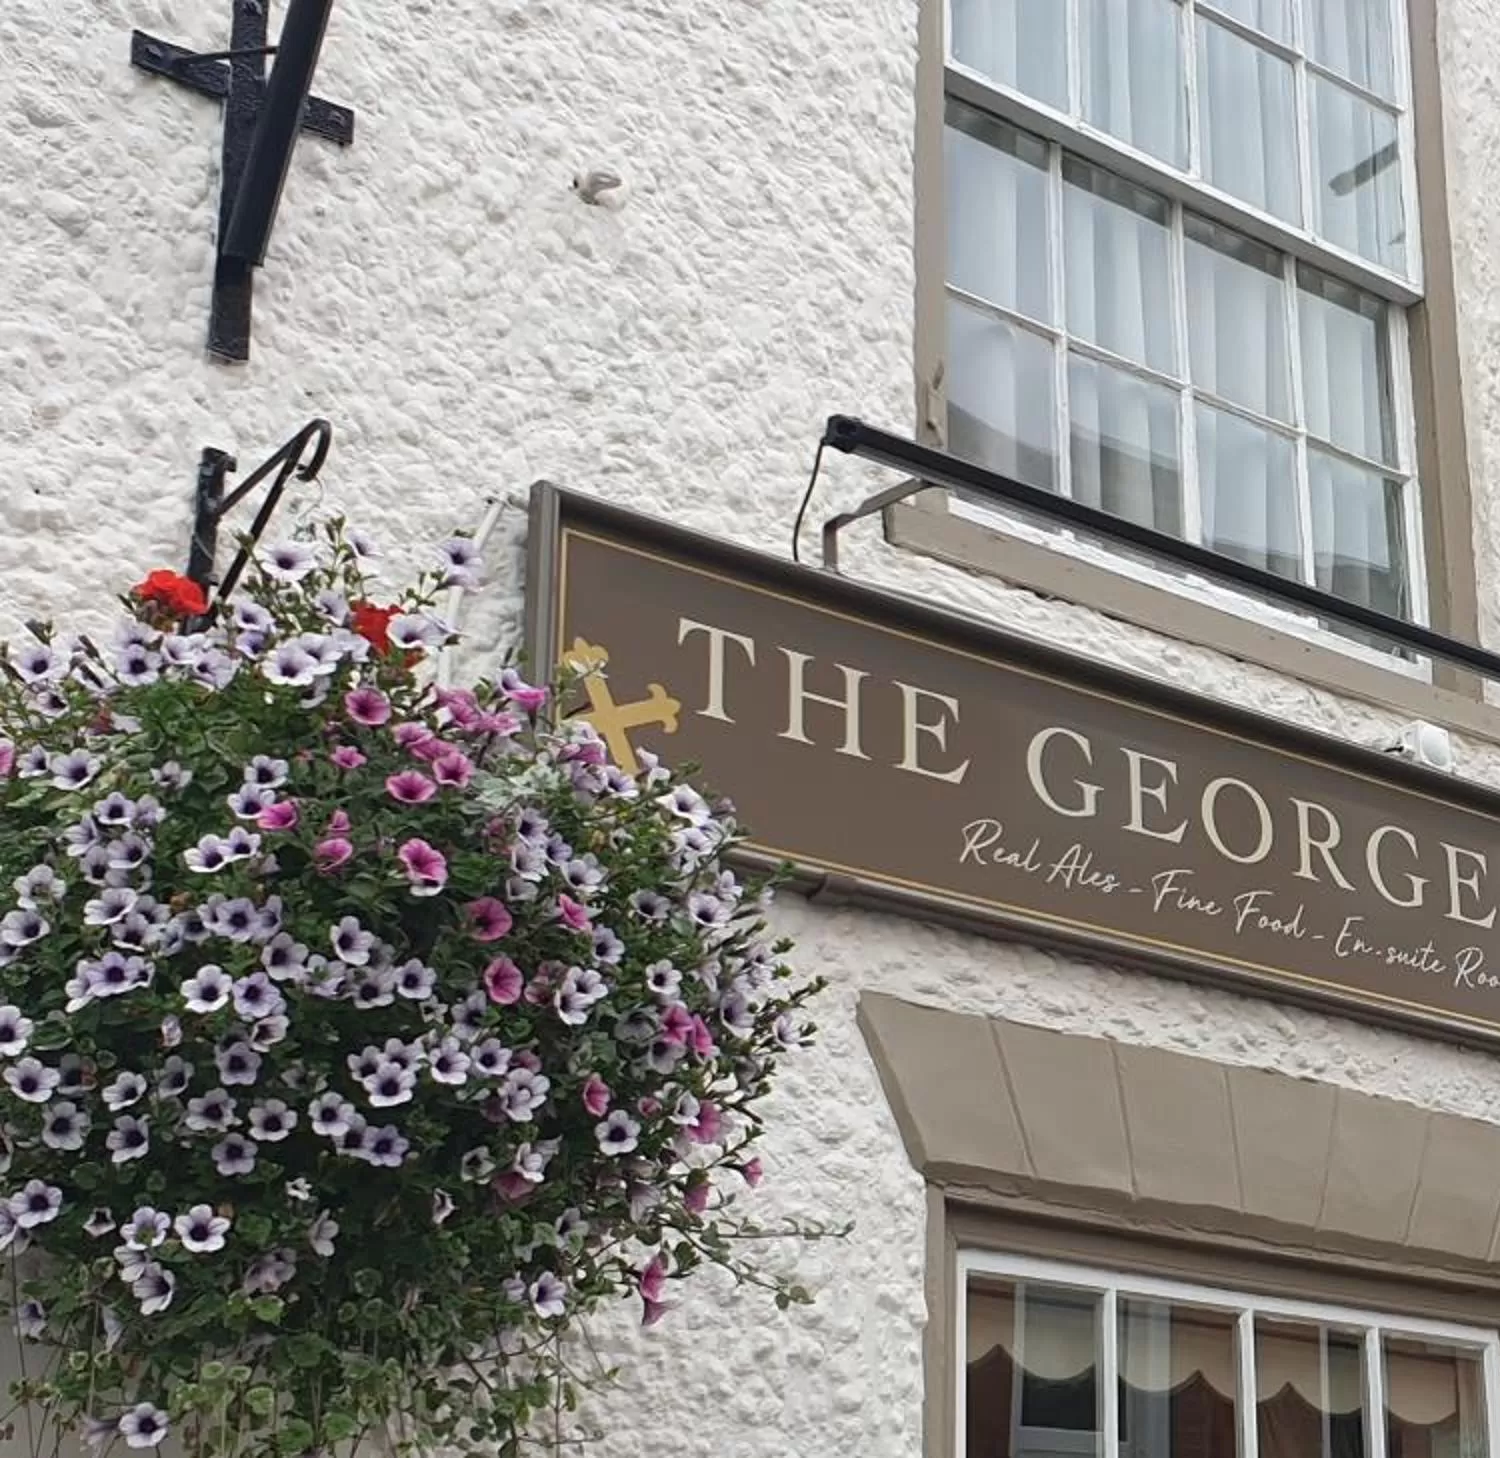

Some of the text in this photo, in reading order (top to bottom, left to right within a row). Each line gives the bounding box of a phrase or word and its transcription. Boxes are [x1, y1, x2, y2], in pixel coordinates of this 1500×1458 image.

[676, 617, 971, 785] THE
[1025, 726, 1499, 930] GEORGE
[959, 818, 1041, 872] Real
[1045, 843, 1121, 894] Ales
[1150, 868, 1224, 916] Fine
[1233, 890, 1306, 935] Food
[1334, 916, 1447, 974] En-suite
